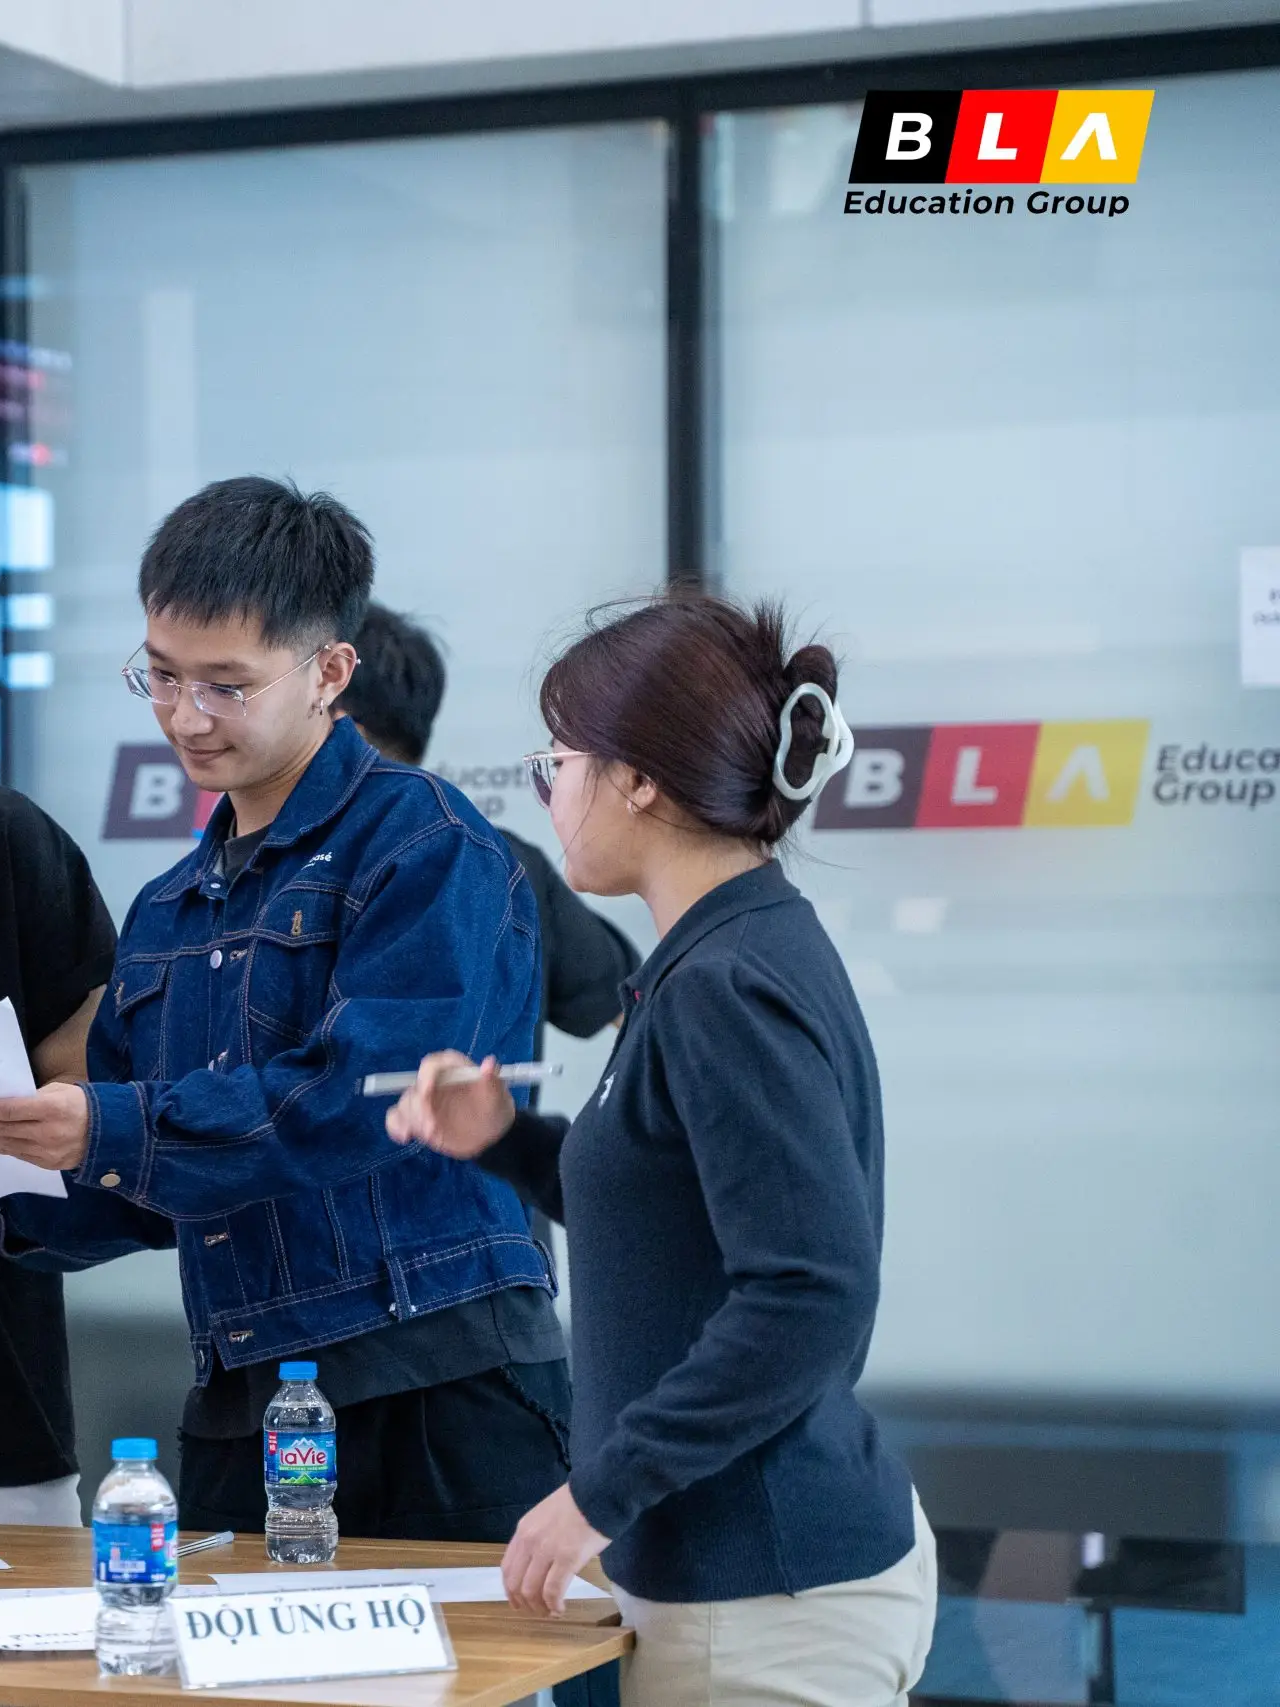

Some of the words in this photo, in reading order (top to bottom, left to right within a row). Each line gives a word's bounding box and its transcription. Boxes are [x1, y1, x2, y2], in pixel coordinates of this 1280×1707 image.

[843, 746, 1111, 808] BLA
[1152, 773, 1276, 811] Group
[279, 1446, 327, 1465] laVie
[184, 1603, 262, 1645] ĐỘI
[365, 1593, 426, 1635] HỘ
